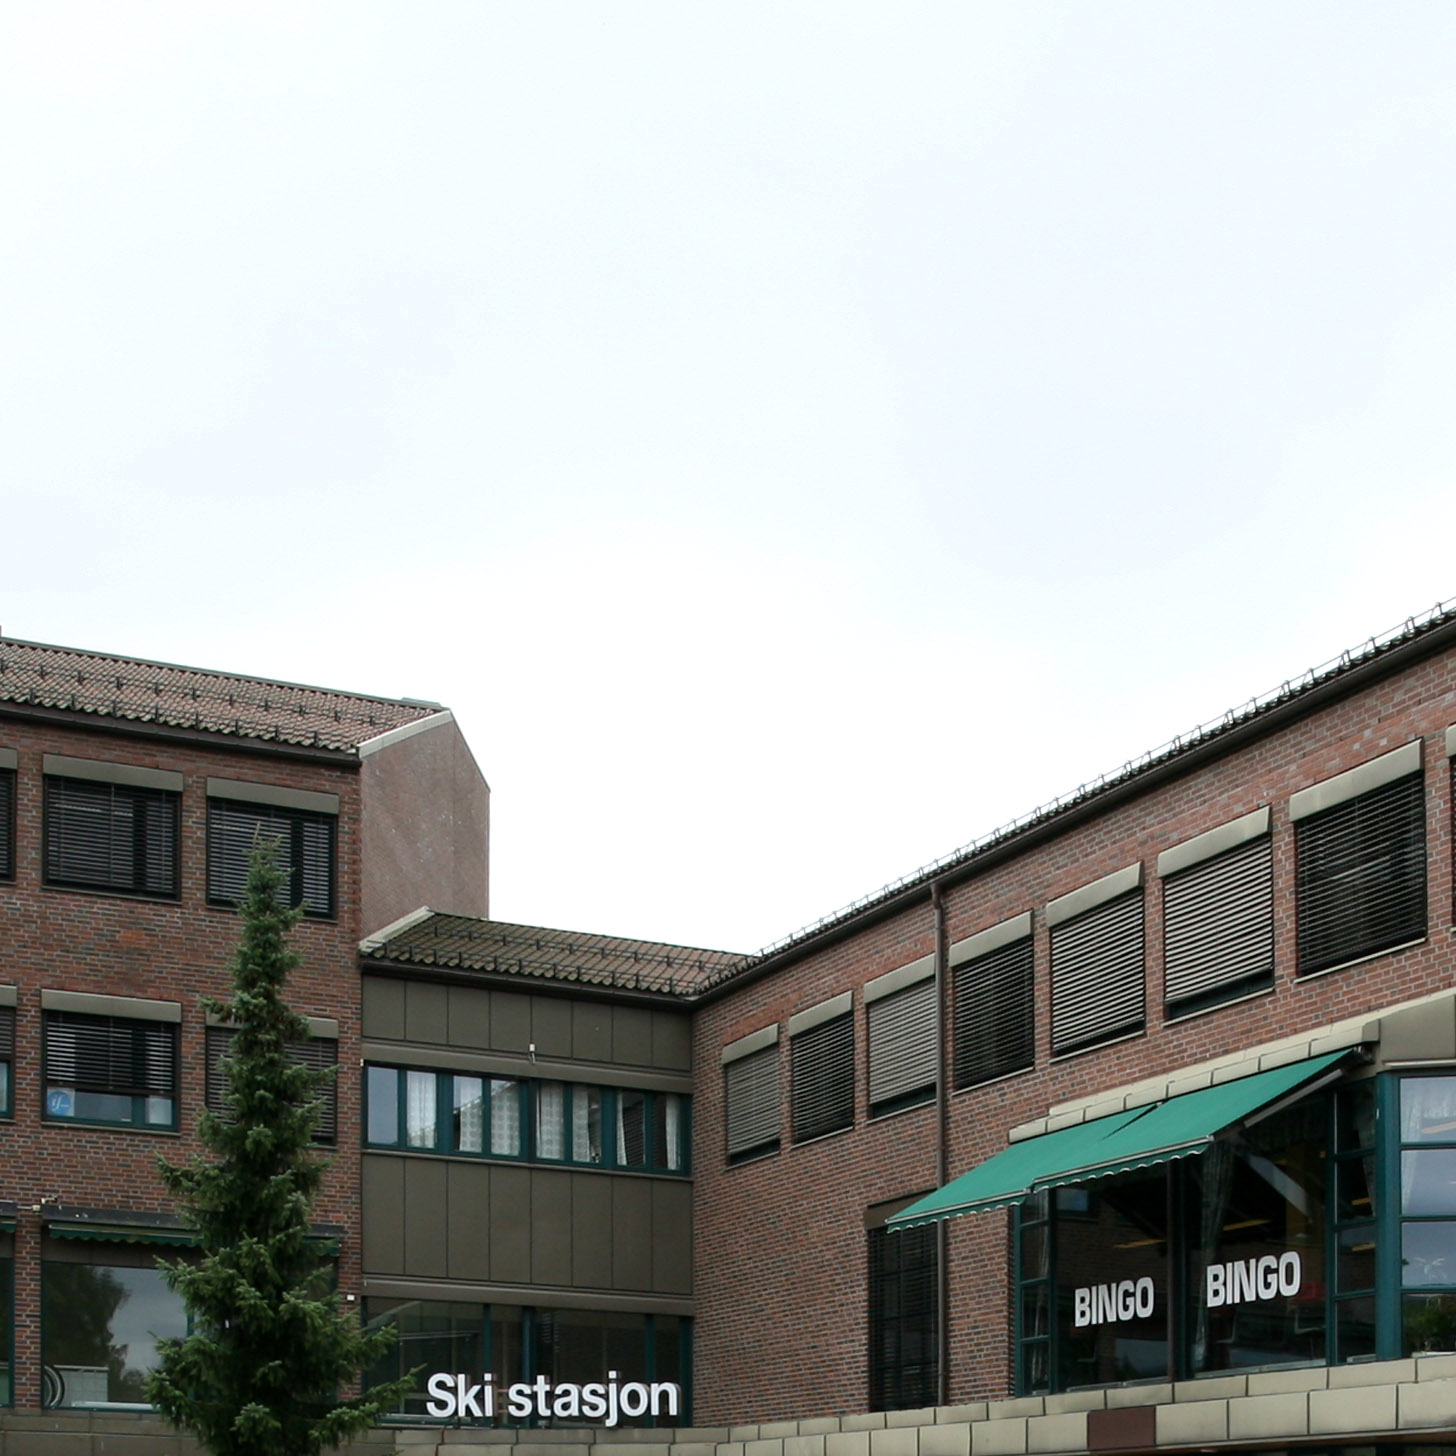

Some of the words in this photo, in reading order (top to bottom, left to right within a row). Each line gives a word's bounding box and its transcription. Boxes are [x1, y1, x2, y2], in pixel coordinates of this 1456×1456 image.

[1075, 1277, 1154, 1328] BINGO
[1208, 1251, 1301, 1308] BINGO
[426, 1372, 493, 1418] Ski
[508, 1370, 678, 1427] stasjon
